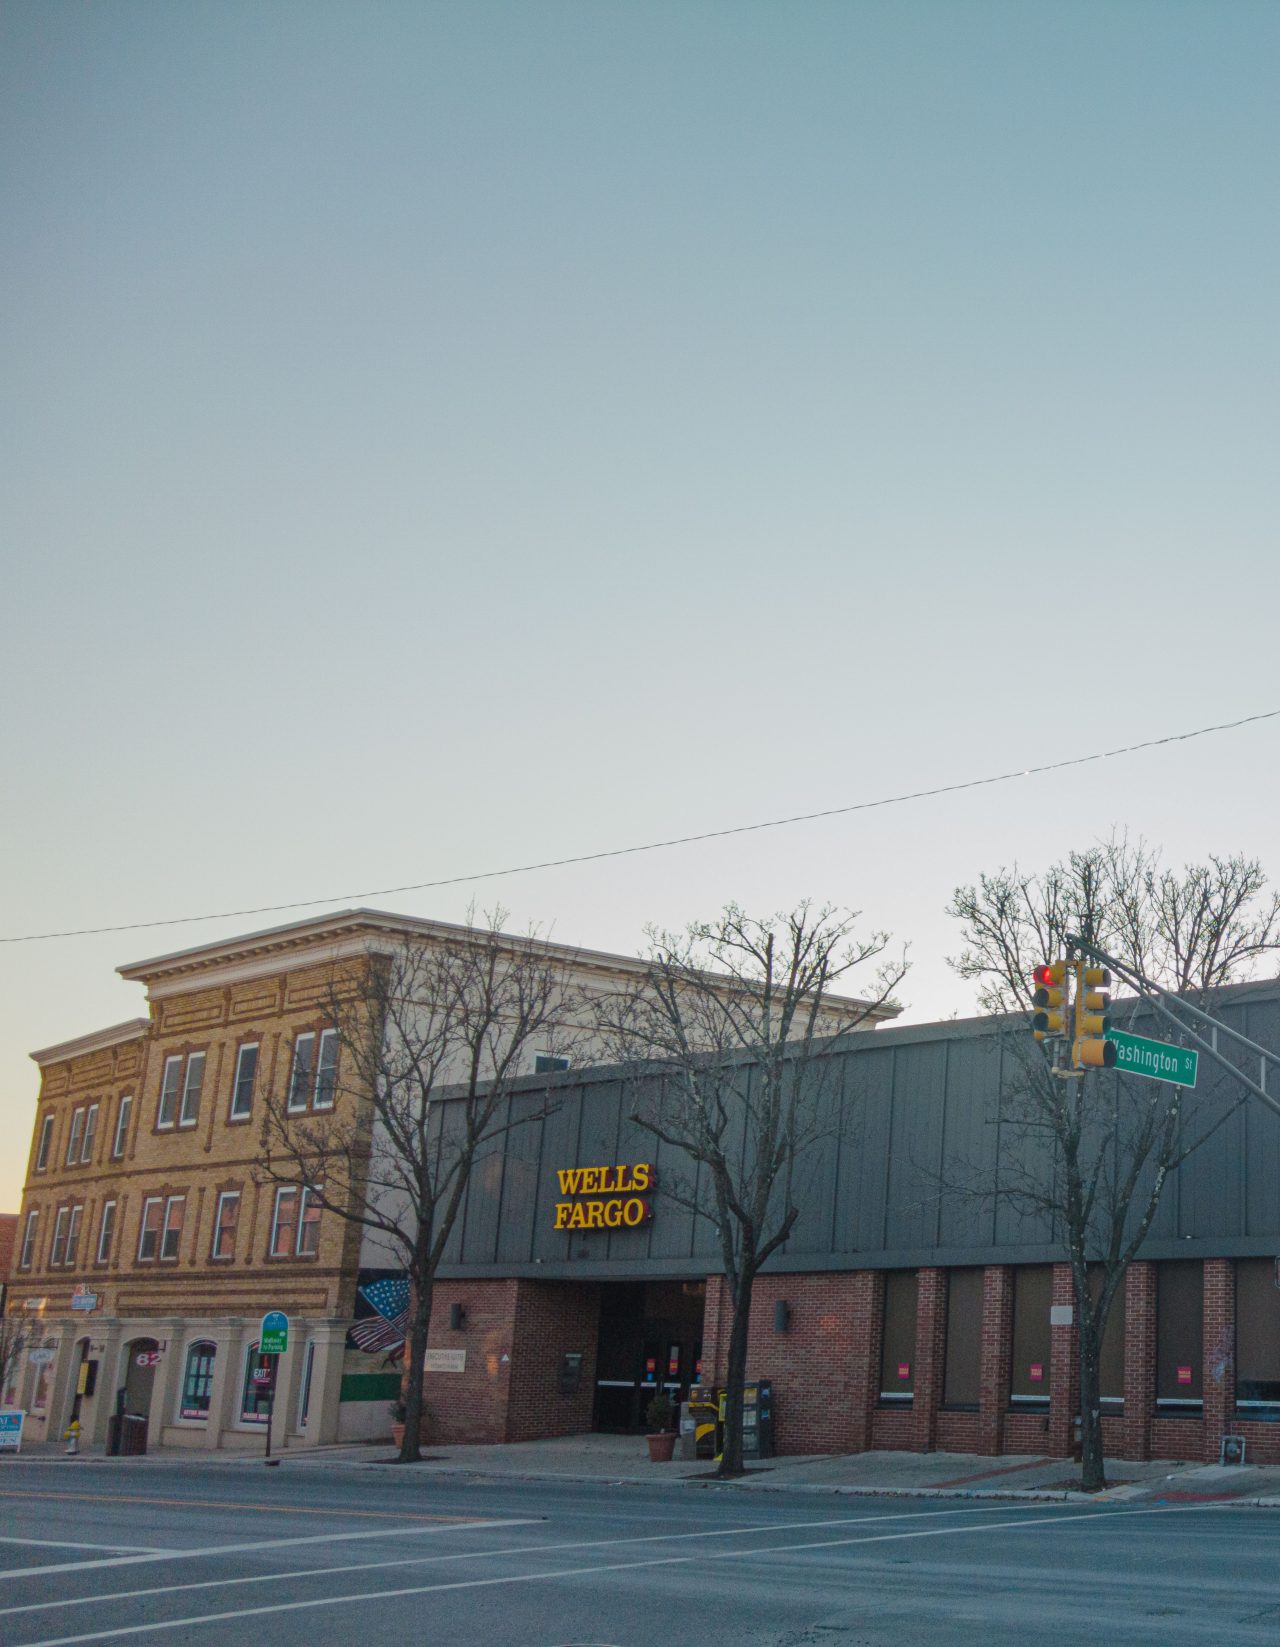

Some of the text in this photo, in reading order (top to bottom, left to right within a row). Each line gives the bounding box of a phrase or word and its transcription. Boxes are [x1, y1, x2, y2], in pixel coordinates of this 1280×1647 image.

[1184, 1057, 1193, 1070] St
[557, 1163, 649, 1194] WELLS
[553, 1198, 644, 1229] FARGO
[136, 1353, 162, 1367] 82
